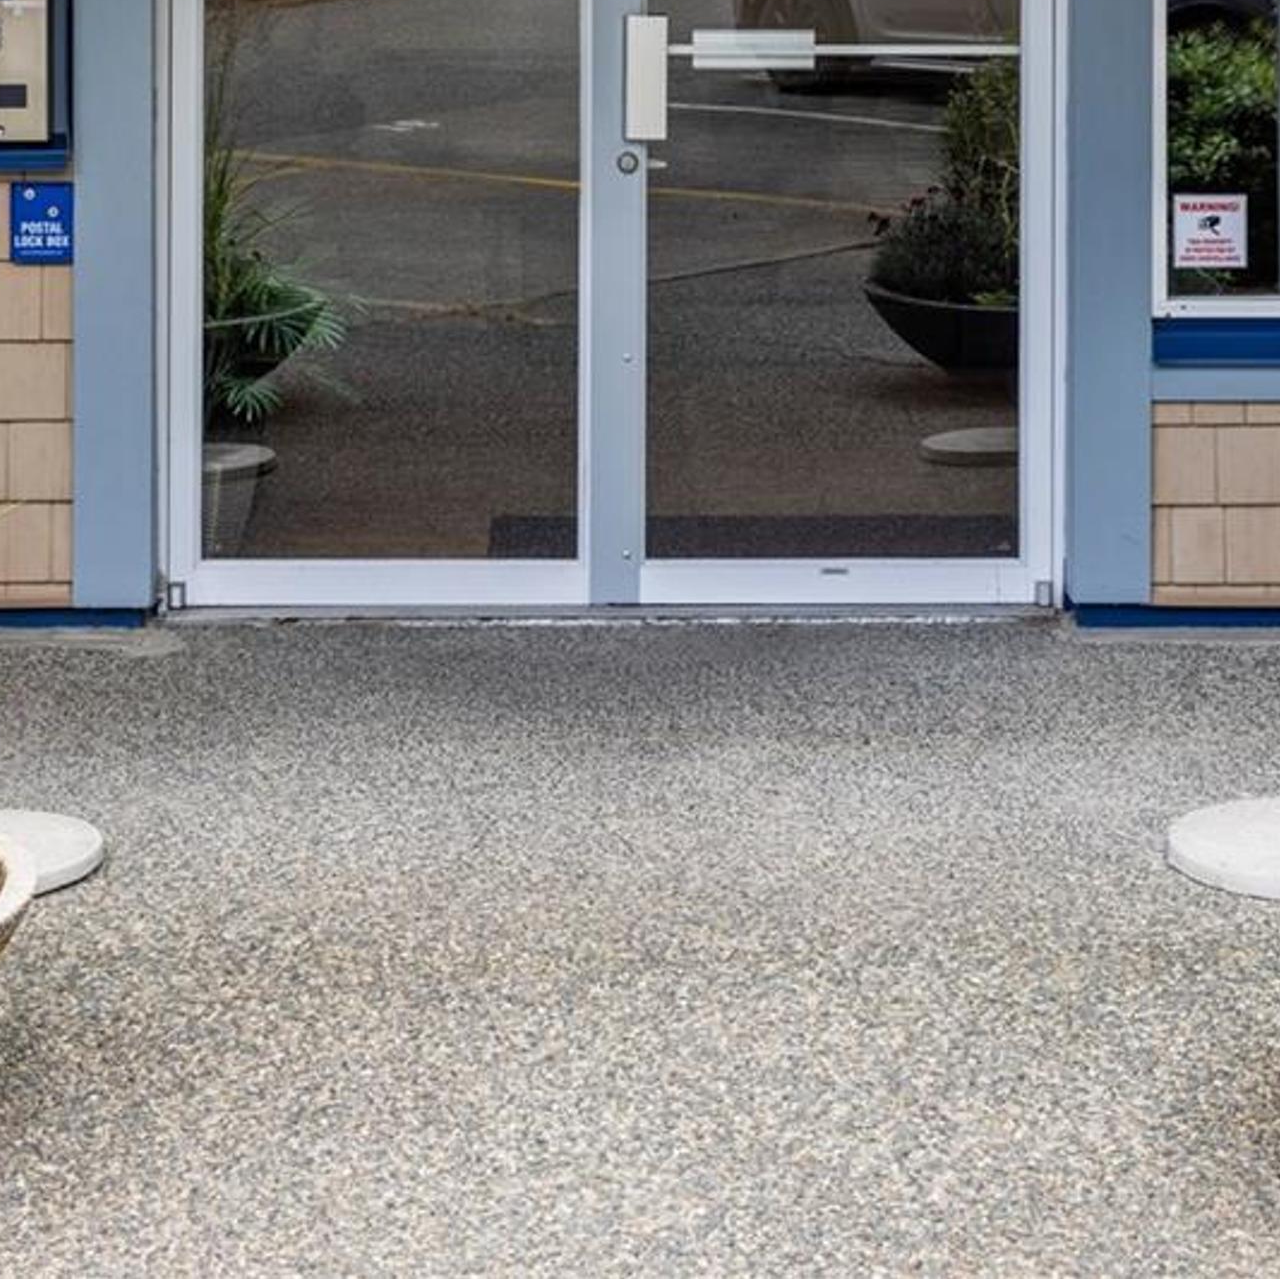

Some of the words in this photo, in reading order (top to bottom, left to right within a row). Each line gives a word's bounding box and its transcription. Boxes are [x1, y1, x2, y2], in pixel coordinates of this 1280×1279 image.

[21, 221, 64, 234] POSTAL
[14, 235, 43, 248] LOCK
[47, 235, 69, 248] BOX
